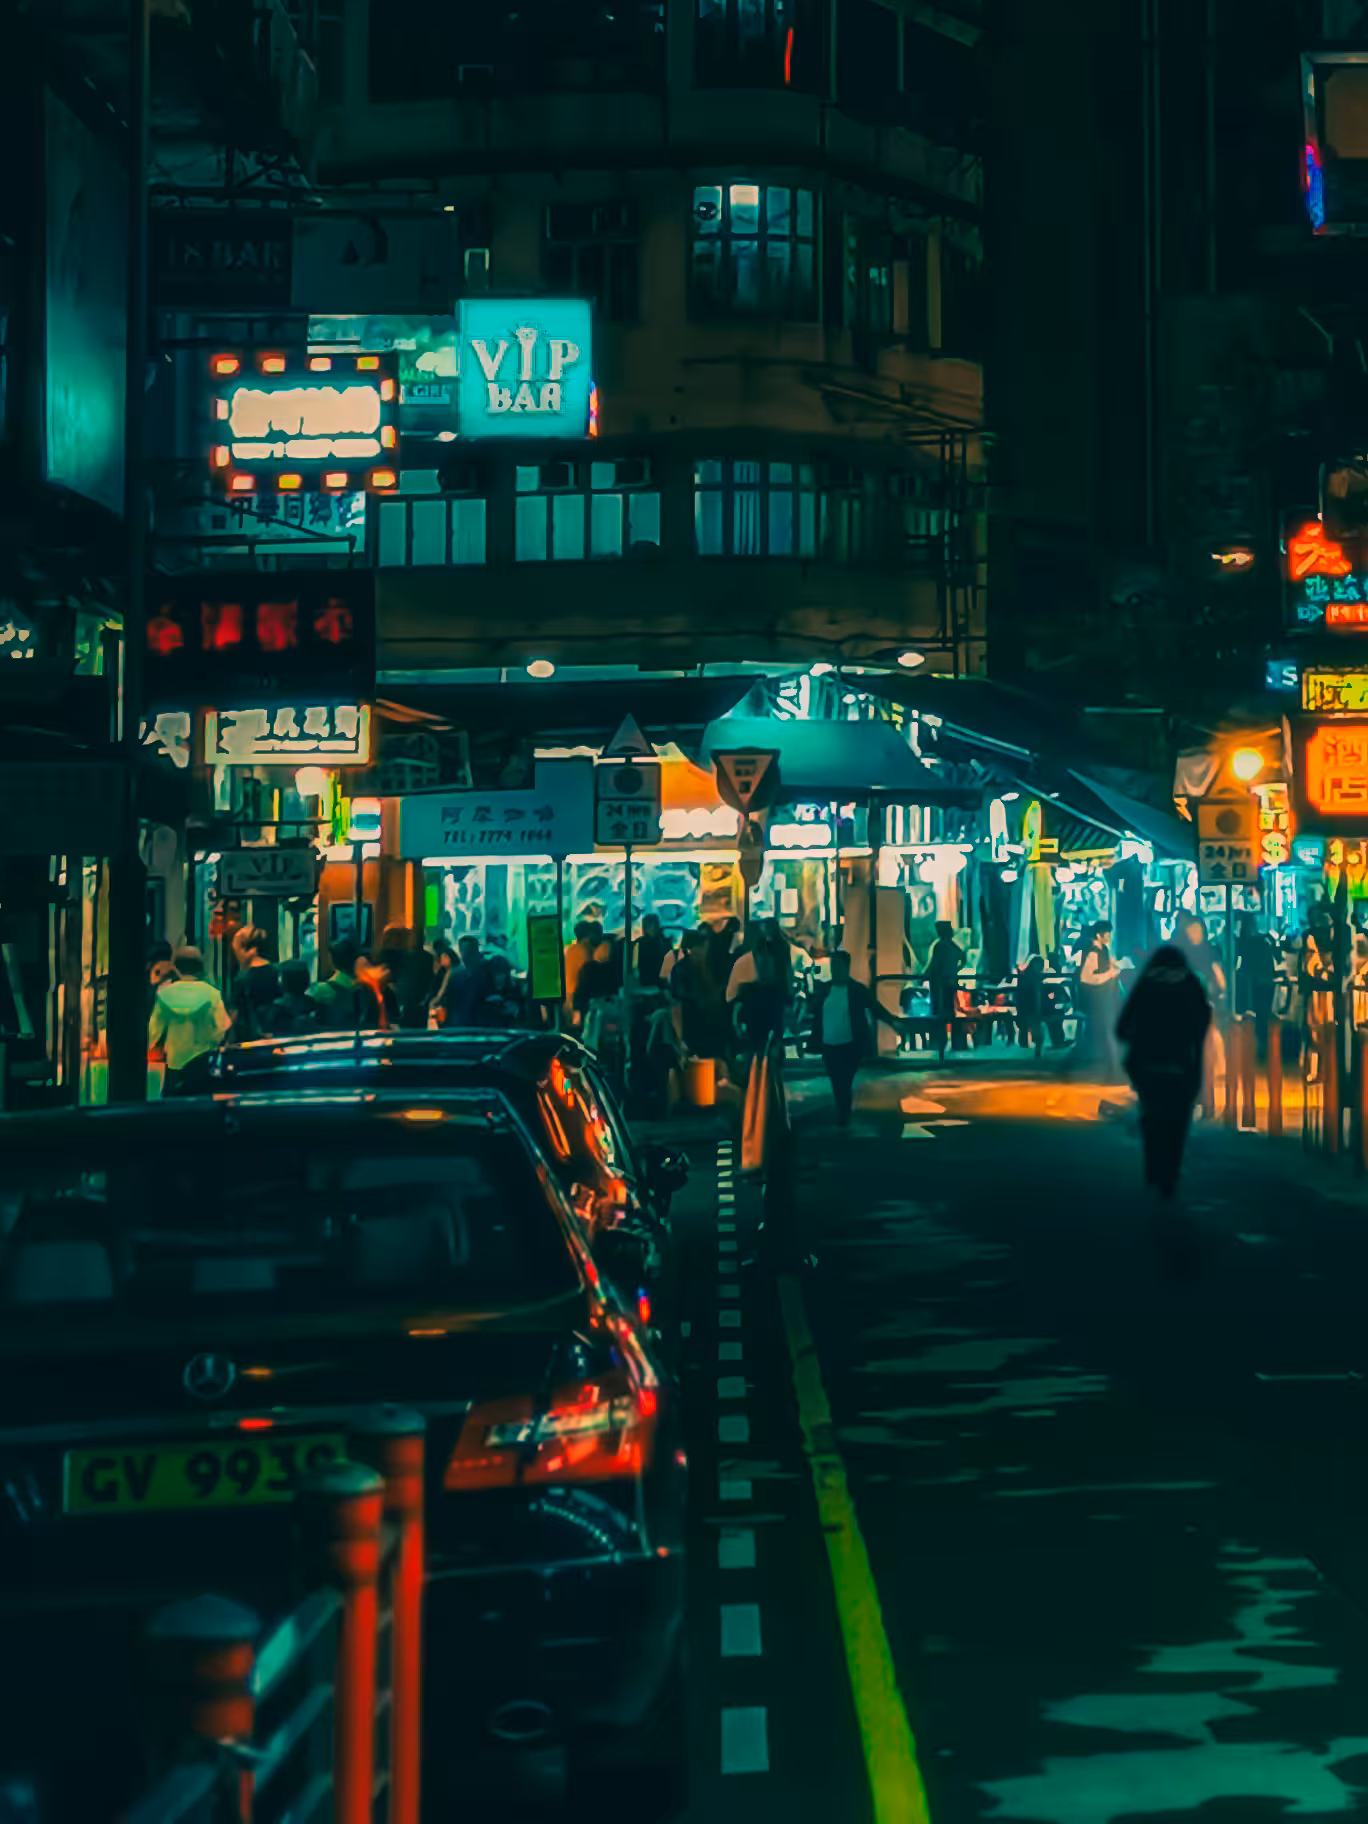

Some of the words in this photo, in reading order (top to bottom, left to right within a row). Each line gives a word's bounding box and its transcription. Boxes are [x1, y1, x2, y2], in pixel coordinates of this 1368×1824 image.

[471, 323, 581, 382] VIP
[487, 380, 563, 414] BAR
[81, 1453, 158, 1505] GV
